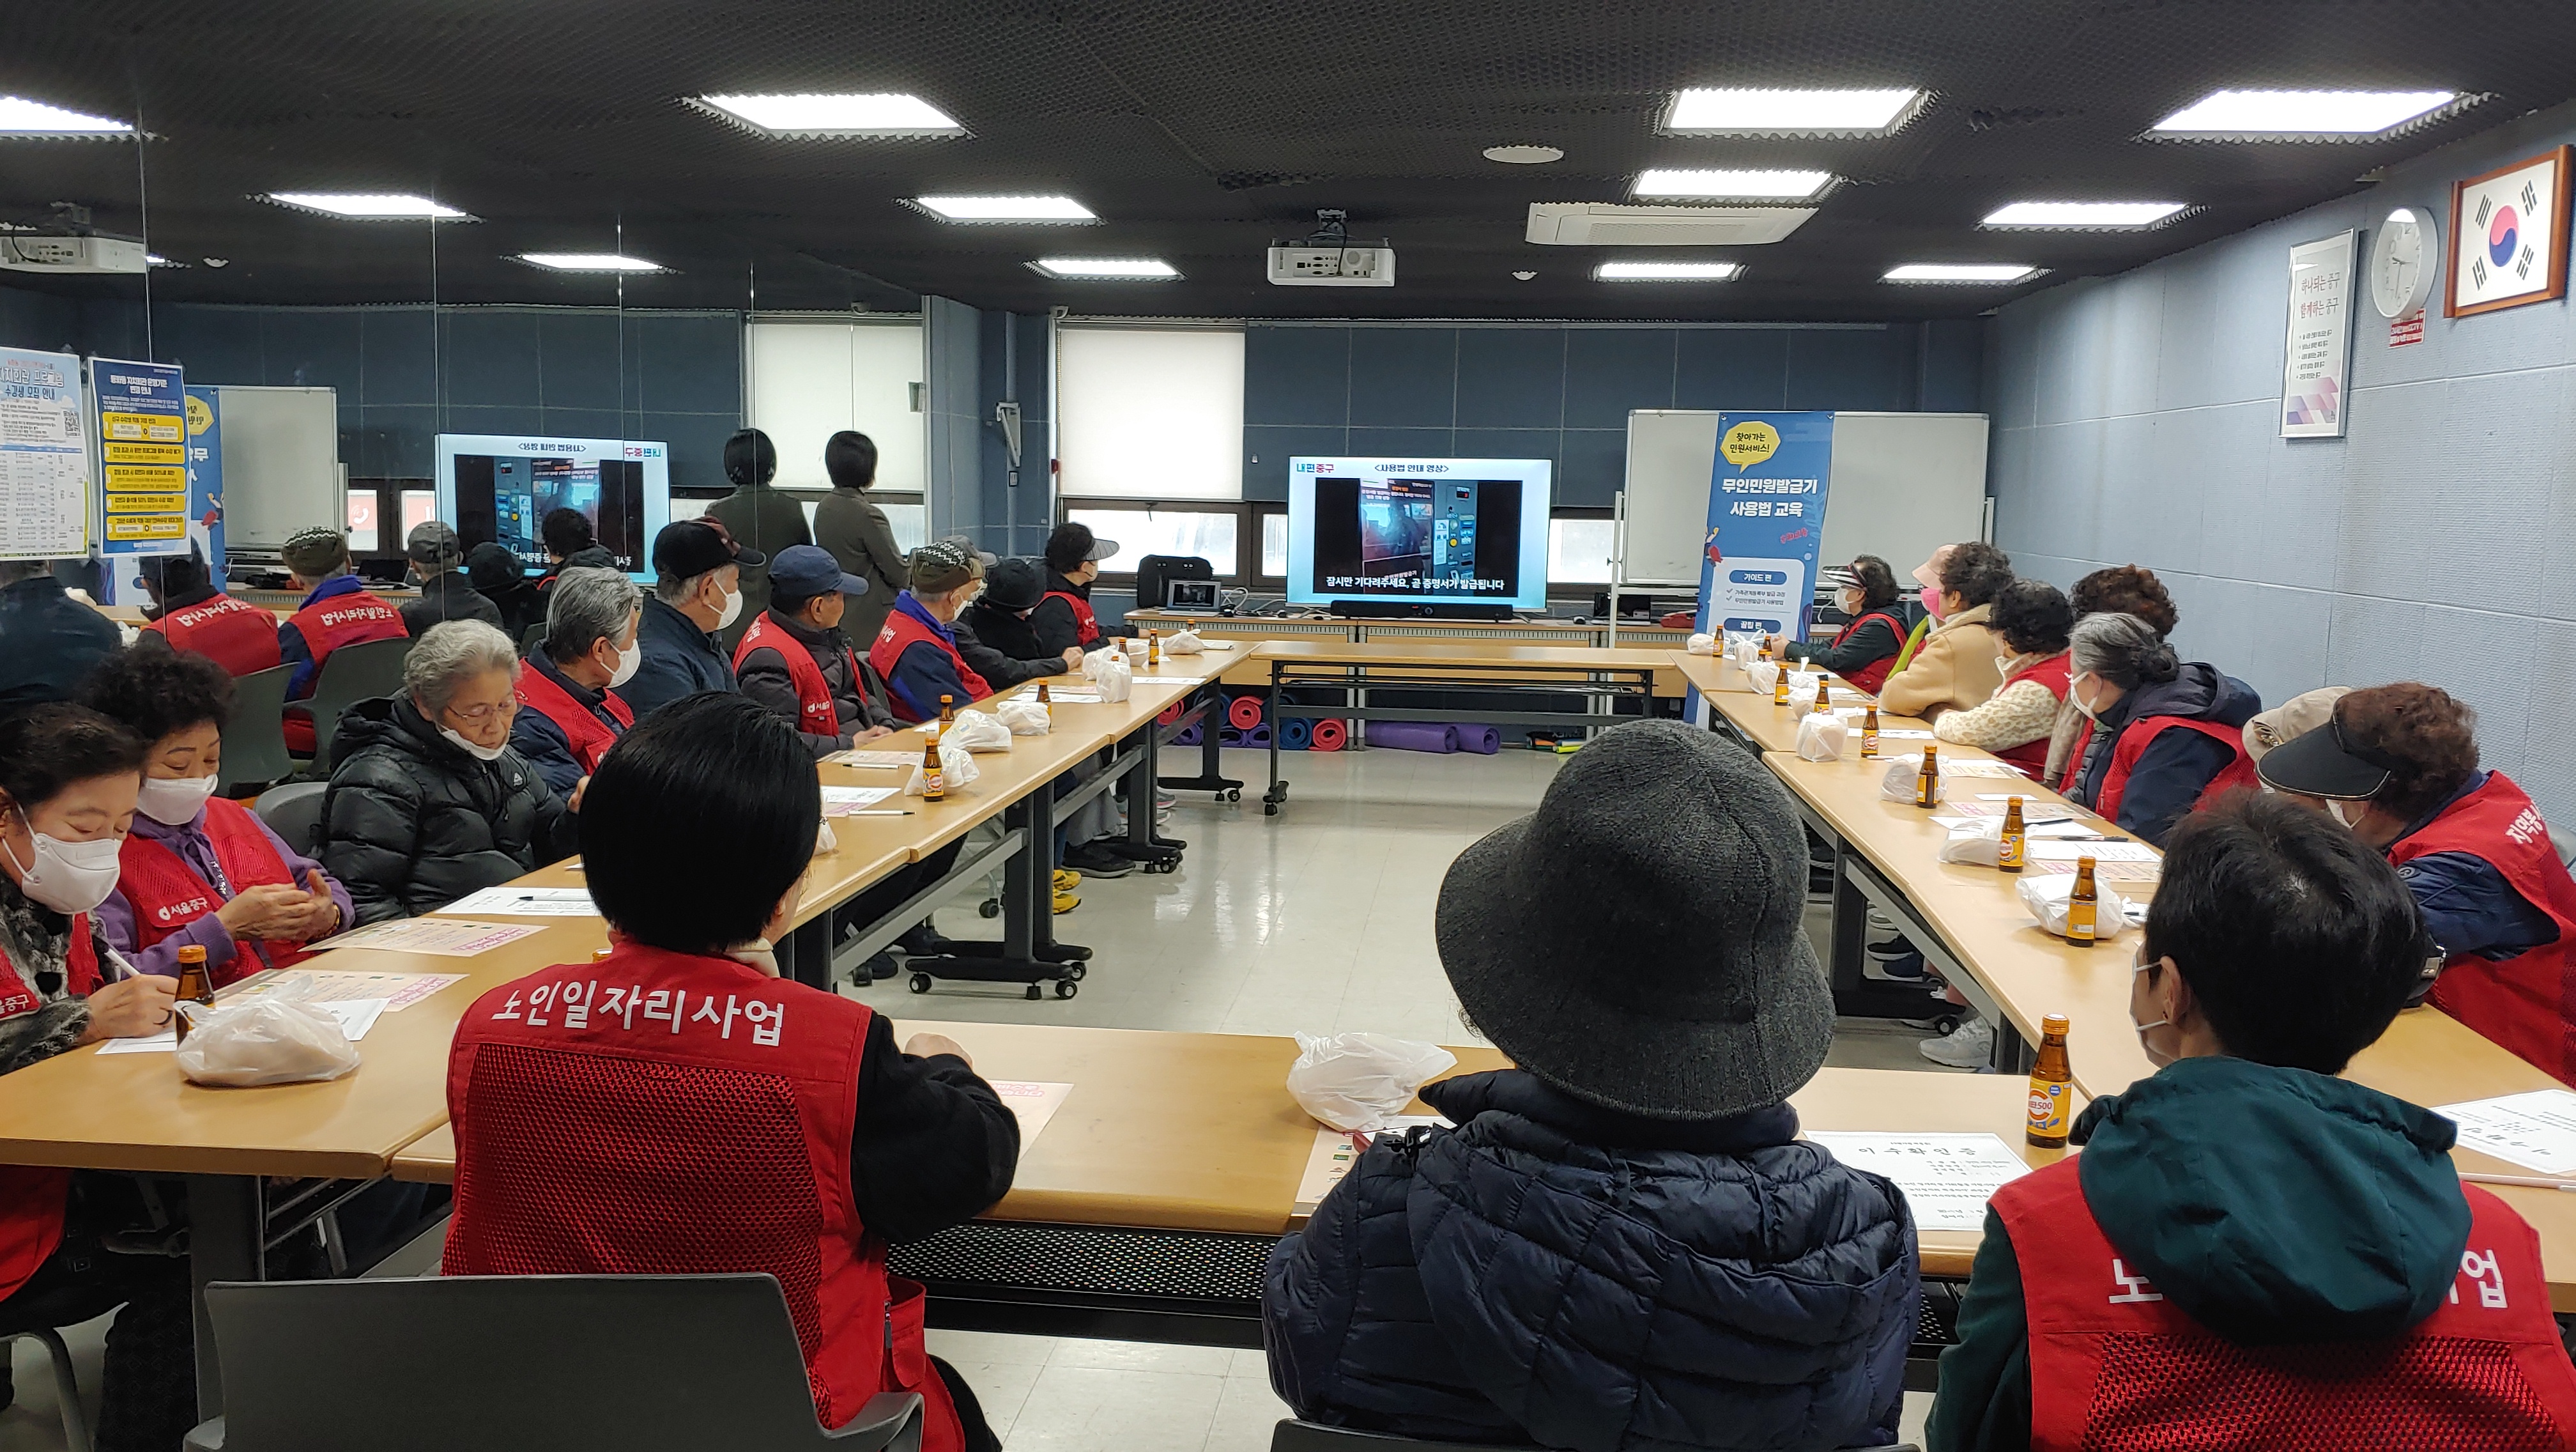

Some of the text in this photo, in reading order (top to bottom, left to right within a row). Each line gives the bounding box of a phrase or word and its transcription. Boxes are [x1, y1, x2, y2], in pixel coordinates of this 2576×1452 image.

[2301, 272, 2340, 295] 하나되는 중구
[2300, 297, 2340, 319] 함께하는 중구
[33, 370, 64, 387] 프로그램
[4, 385, 56, 400] 수강생 모집 안내
[1736, 433, 1766, 442] 찾아가는
[1730, 444, 1770, 453] 민원서비스!
[1296, 463, 1335, 474] 내편중구
[1374, 464, 1405, 472] <사용법
[1426, 465, 1450, 473] 영상>
[1722, 479, 1818, 494] 무인민원발급기
[1729, 501, 1804, 517] 사용법 교육
[1326, 576, 1505, 591] 잠시만 기다려주세요, 곧 증명서가 발급됩니다
[1744, 573, 1772, 582] 가이드 편
[171, 897, 208, 915] 서울중구
[490, 980, 785, 1047] 노인일자리사업
